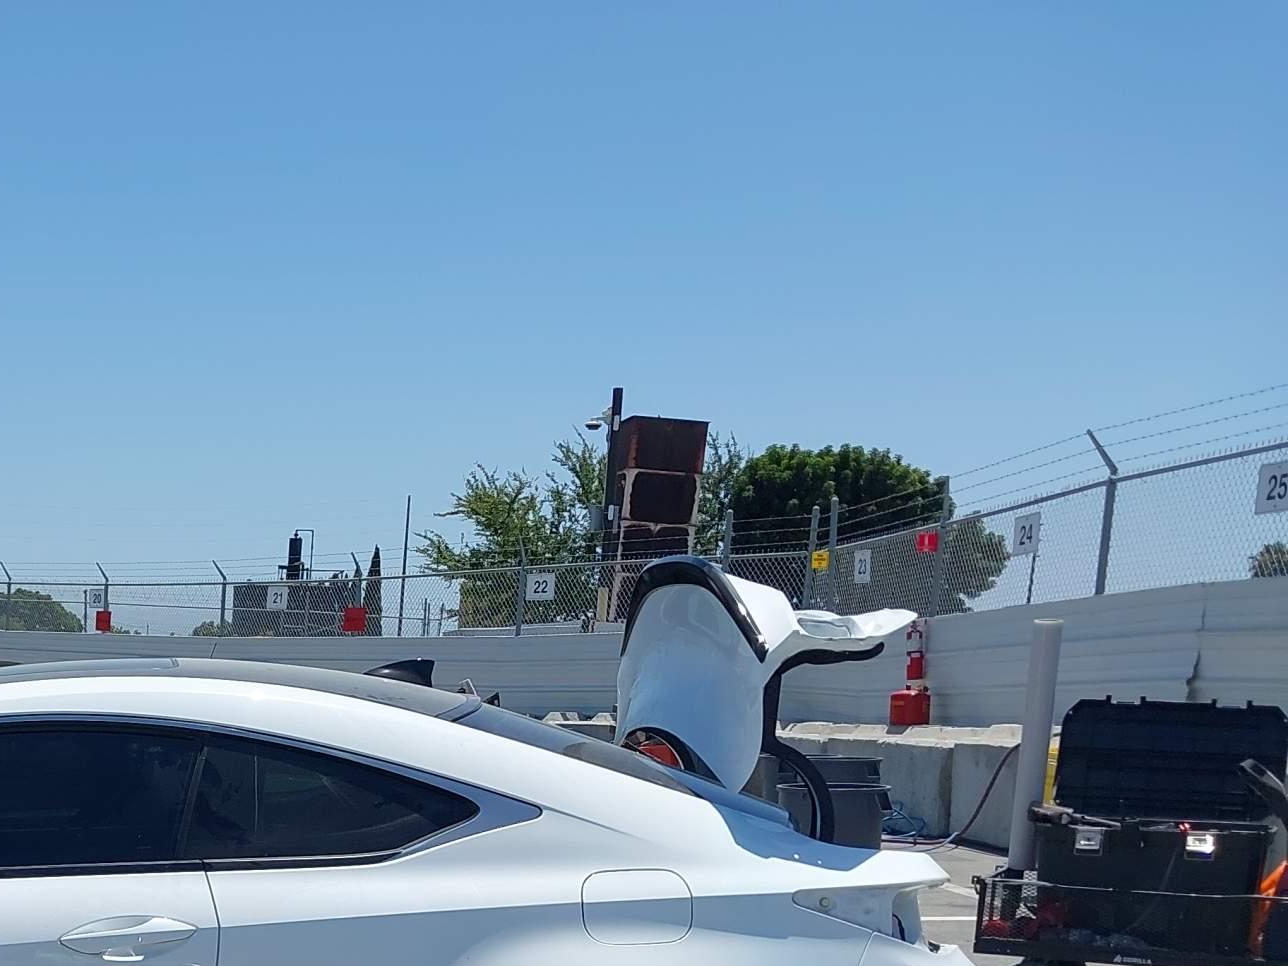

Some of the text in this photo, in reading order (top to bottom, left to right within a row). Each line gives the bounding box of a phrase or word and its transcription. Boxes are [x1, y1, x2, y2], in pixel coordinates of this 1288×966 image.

[1265, 472, 1288, 501] 25
[1018, 524, 1033, 546] 24
[857, 558, 867, 575] 23
[533, 580, 549, 594] 22
[92, 593, 102, 604] 20
[272, 592, 283, 604] 21
